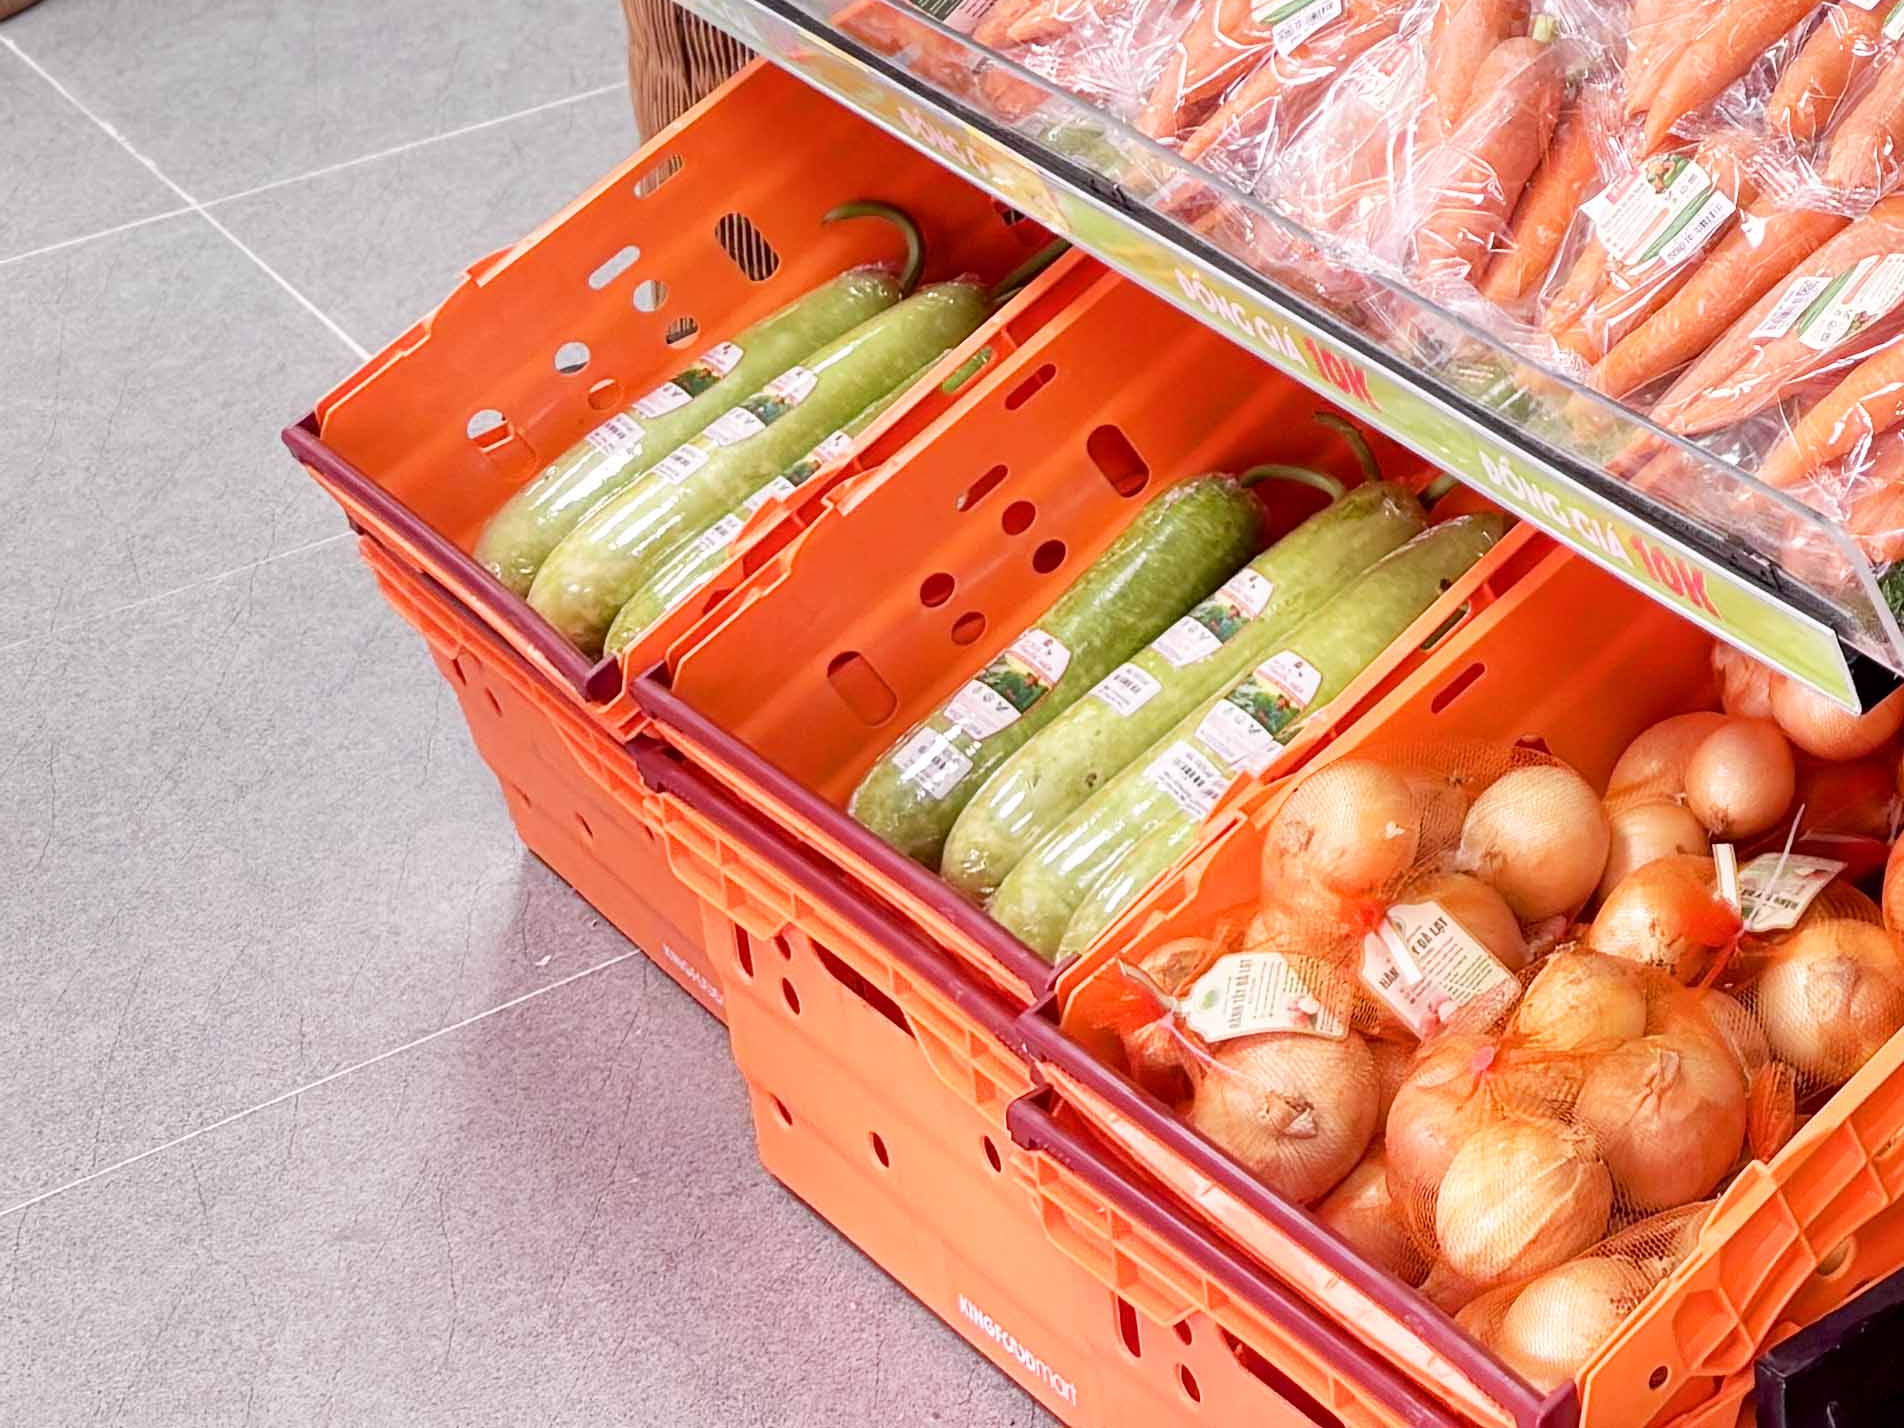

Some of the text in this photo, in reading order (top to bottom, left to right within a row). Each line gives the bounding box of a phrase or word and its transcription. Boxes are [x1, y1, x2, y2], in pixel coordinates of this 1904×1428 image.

[1175, 268, 1382, 412] ĐỒNG GIÁ 10K
[1479, 448, 1722, 619] ĐỒNG GIÁ 10K
[1378, 958, 1402, 991] HÀN
